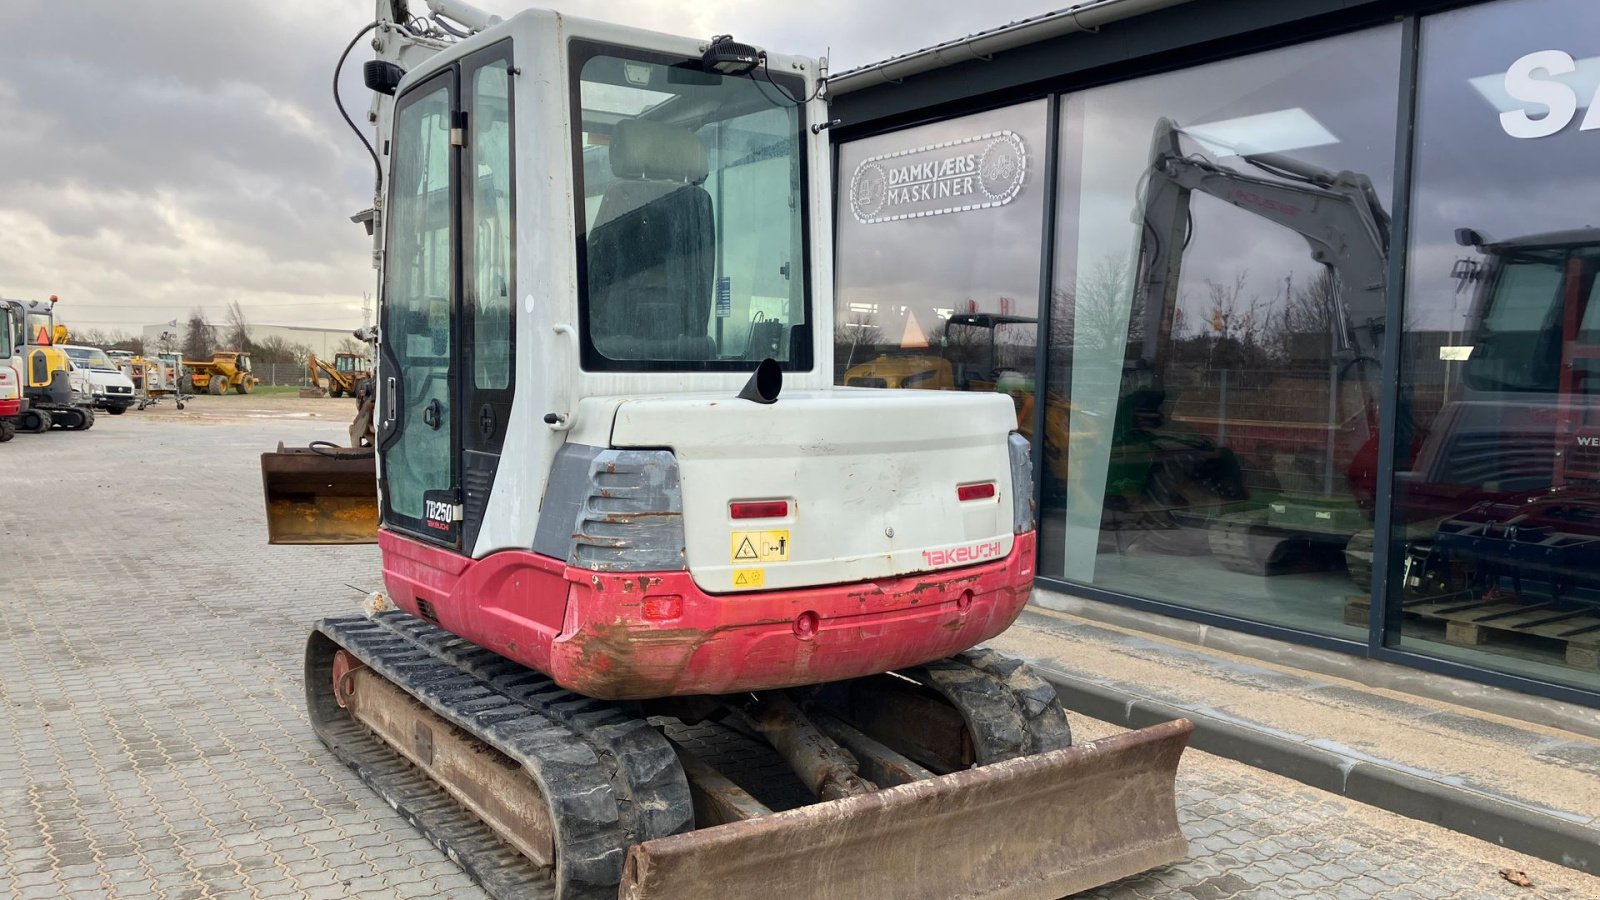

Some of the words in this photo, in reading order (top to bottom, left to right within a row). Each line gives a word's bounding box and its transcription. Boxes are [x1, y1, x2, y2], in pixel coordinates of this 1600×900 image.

[1500, 50, 1600, 138] S
[889, 154, 975, 184] DAMKJÆRS
[888, 177, 973, 206] MASKINER
[1577, 437, 1600, 447] WE
[426, 500, 452, 523] TB250
